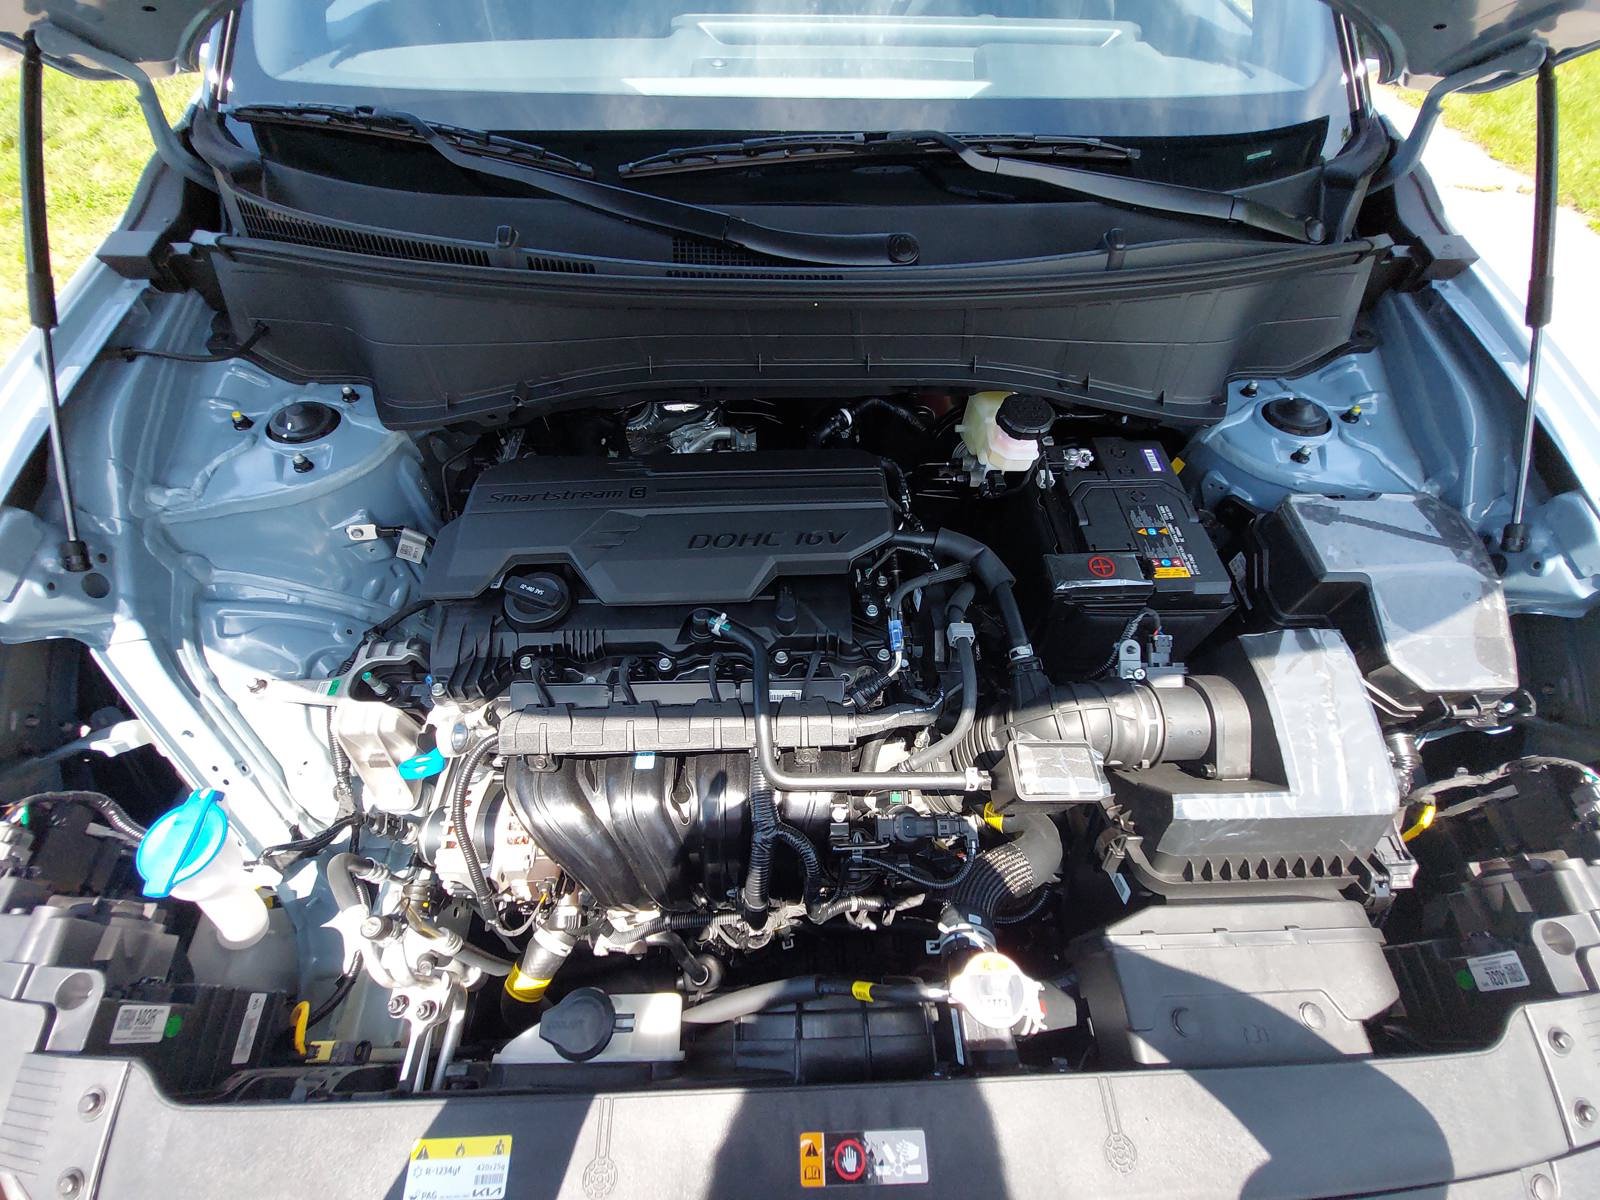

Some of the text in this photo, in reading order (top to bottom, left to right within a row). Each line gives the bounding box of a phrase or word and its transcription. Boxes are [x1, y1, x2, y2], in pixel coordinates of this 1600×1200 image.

[488, 489, 623, 503] Smartstream
[687, 529, 849, 549] DOHC 16V
[520, 583, 535, 592] 0W-20
[425, 1166, 461, 1177] R-1234yf
[472, 1187, 502, 1198] KIA
